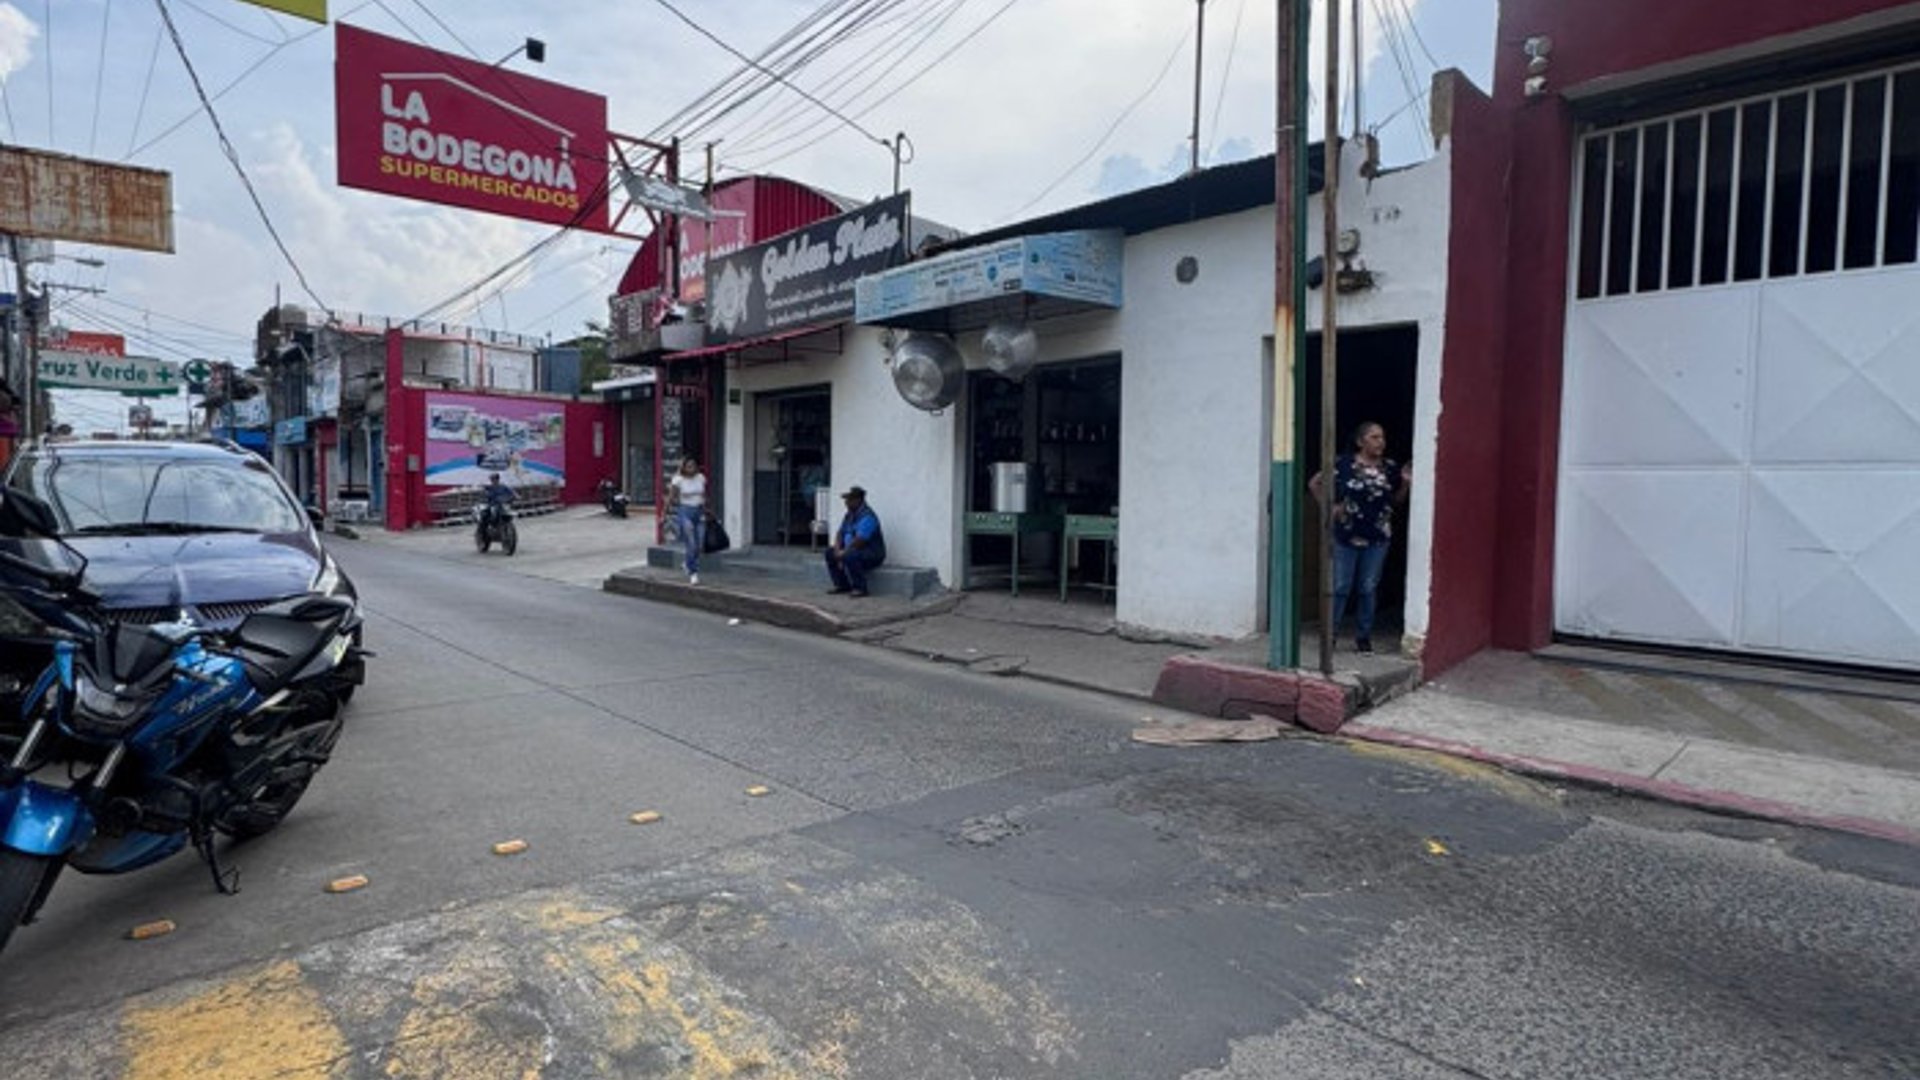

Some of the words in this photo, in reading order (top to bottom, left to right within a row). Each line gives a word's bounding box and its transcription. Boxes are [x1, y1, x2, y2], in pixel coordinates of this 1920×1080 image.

[382, 83, 430, 124] LA
[380, 155, 580, 210] SUPERMERCADOS
[761, 234, 832, 295] Golden
[38, 357, 78, 377] ruz
[85, 359, 149, 384] Verde
